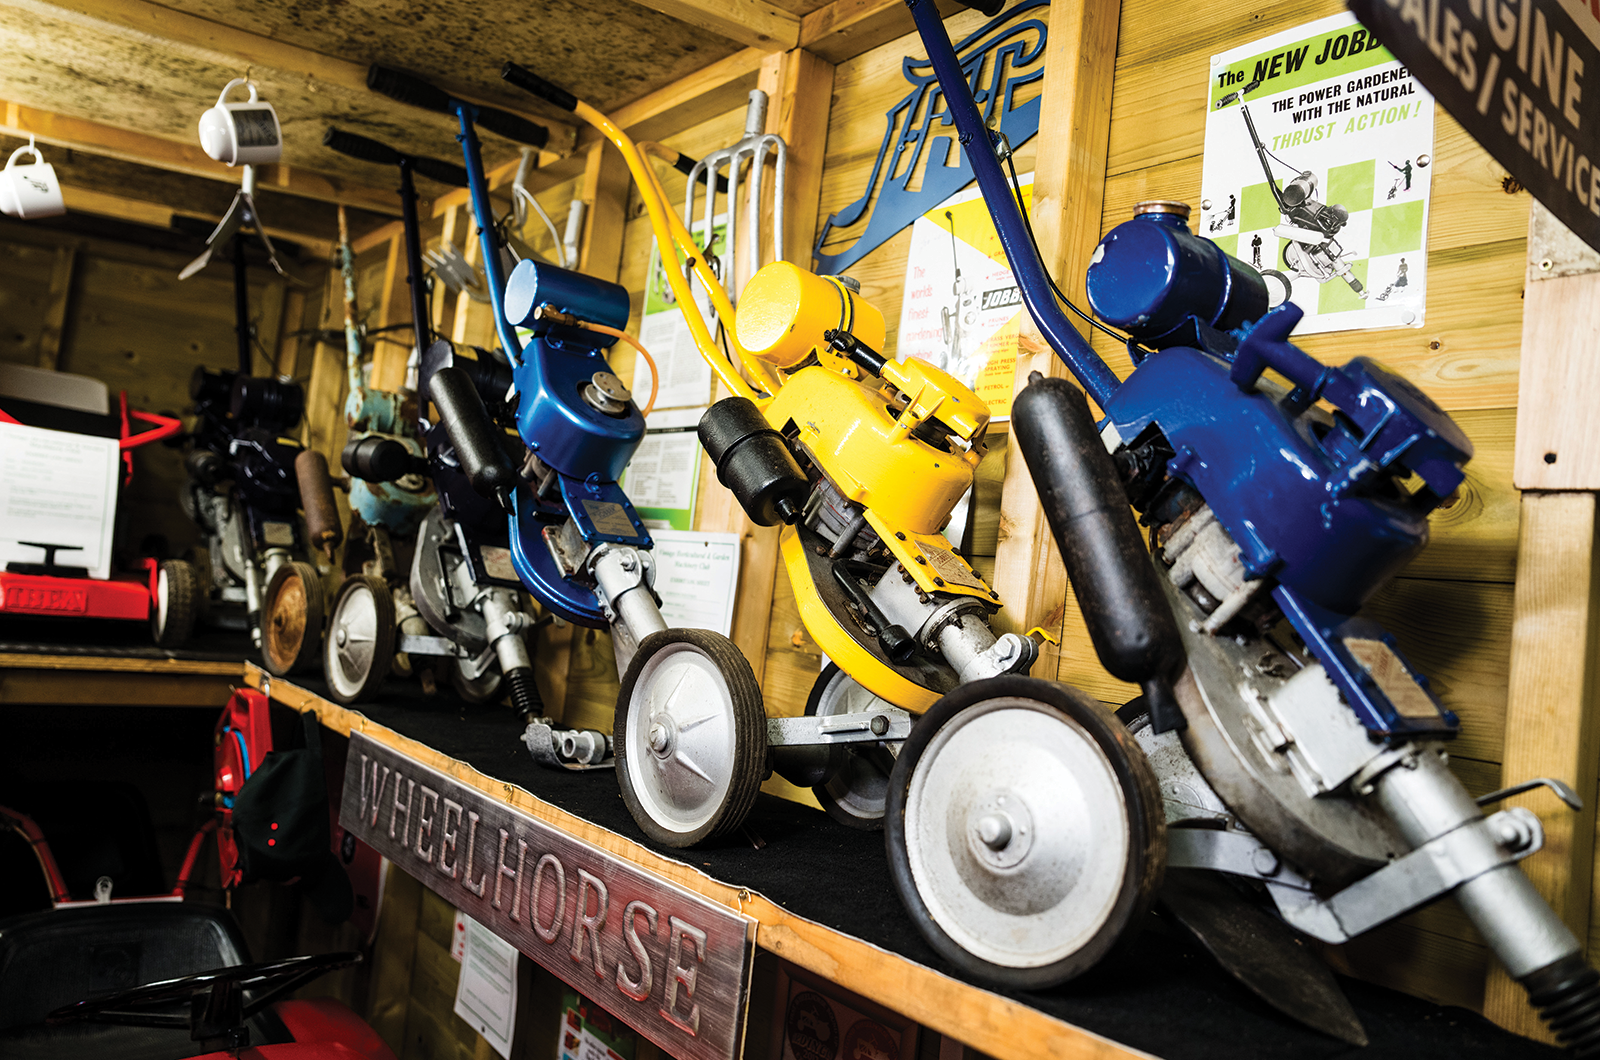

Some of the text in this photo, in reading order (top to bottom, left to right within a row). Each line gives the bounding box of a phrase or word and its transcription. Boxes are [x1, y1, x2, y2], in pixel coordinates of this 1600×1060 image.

[1218, 71, 1245, 88] The
[1253, 45, 1310, 83] NEW
[1467, 0, 1584, 129] GINE
[1271, 66, 1413, 114] THE POWER GARDENE
[1292, 82, 1416, 124] WITH THE NATURAL
[1384, 0, 1477, 92] ALES
[1501, 77, 1600, 216] SERVICE
[1272, 121, 1337, 152] THRUST
[982, 287, 1022, 310] JOBB
